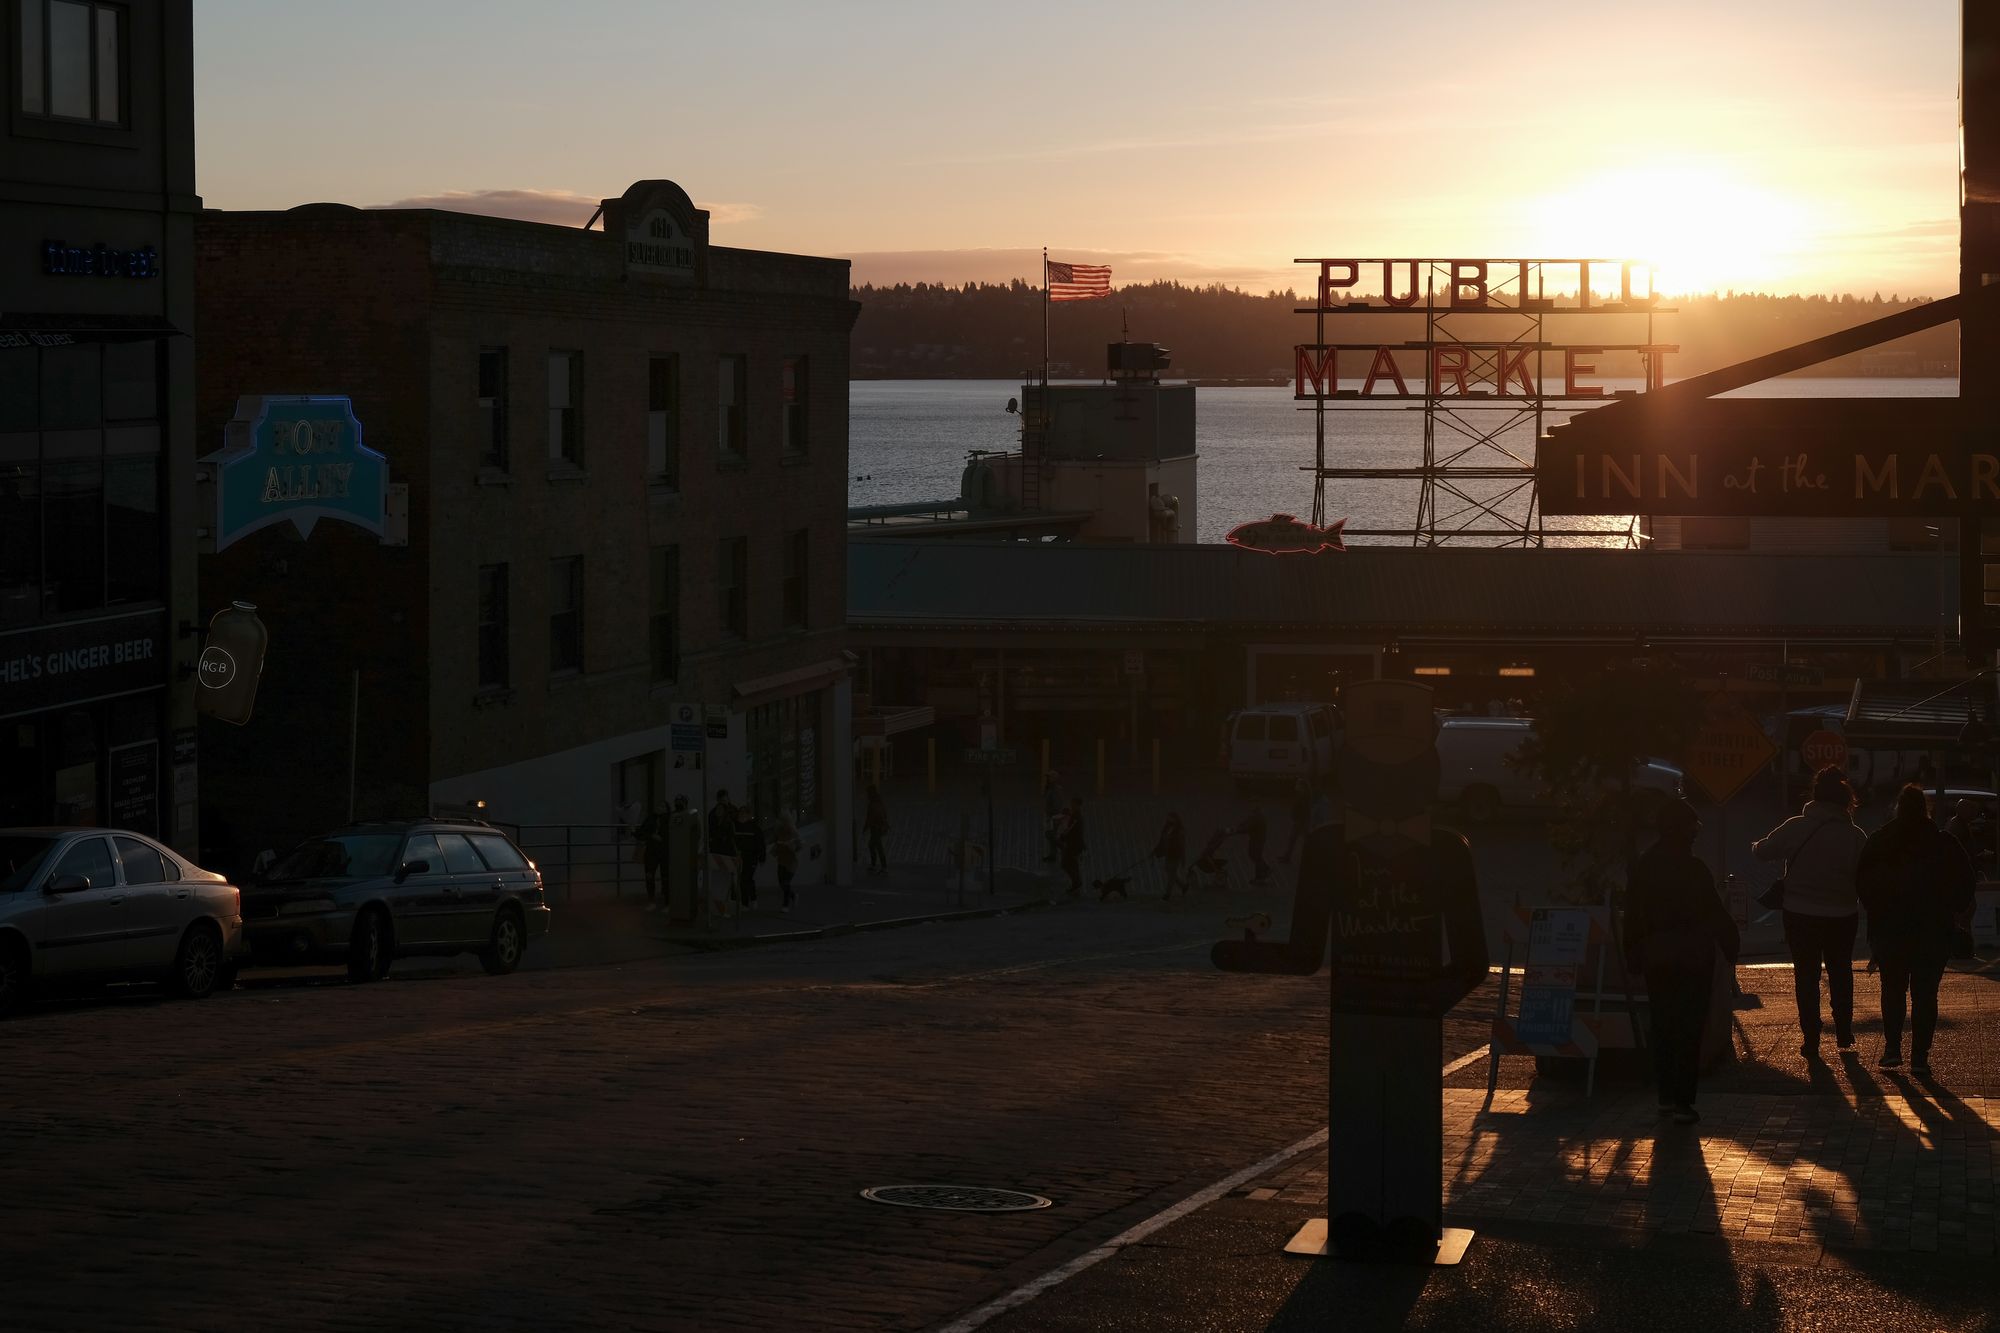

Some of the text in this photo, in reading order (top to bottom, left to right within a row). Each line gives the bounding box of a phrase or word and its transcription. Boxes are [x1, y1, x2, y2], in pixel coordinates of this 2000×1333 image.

[1321, 259, 1659, 308] PUBLIC
[1295, 345, 1678, 396] MARKET
[262, 462, 355, 503] ALLEY
[1576, 453, 1698, 499] INN
[1723, 456, 1766, 494] at
[1779, 453, 1829, 493] the
[47, 645, 110, 676] GINGER
[114, 638, 153, 664] BEER
[202, 660, 227, 674] RGB
[1750, 665, 1778, 681] Post
[1697, 751, 1744, 769] STREET
[1807, 744, 1844, 760] STOP
[1359, 881, 1423, 910] at the
[1338, 911, 1435, 938] Market
[1518, 1023, 1568, 1034] PRIORITY
